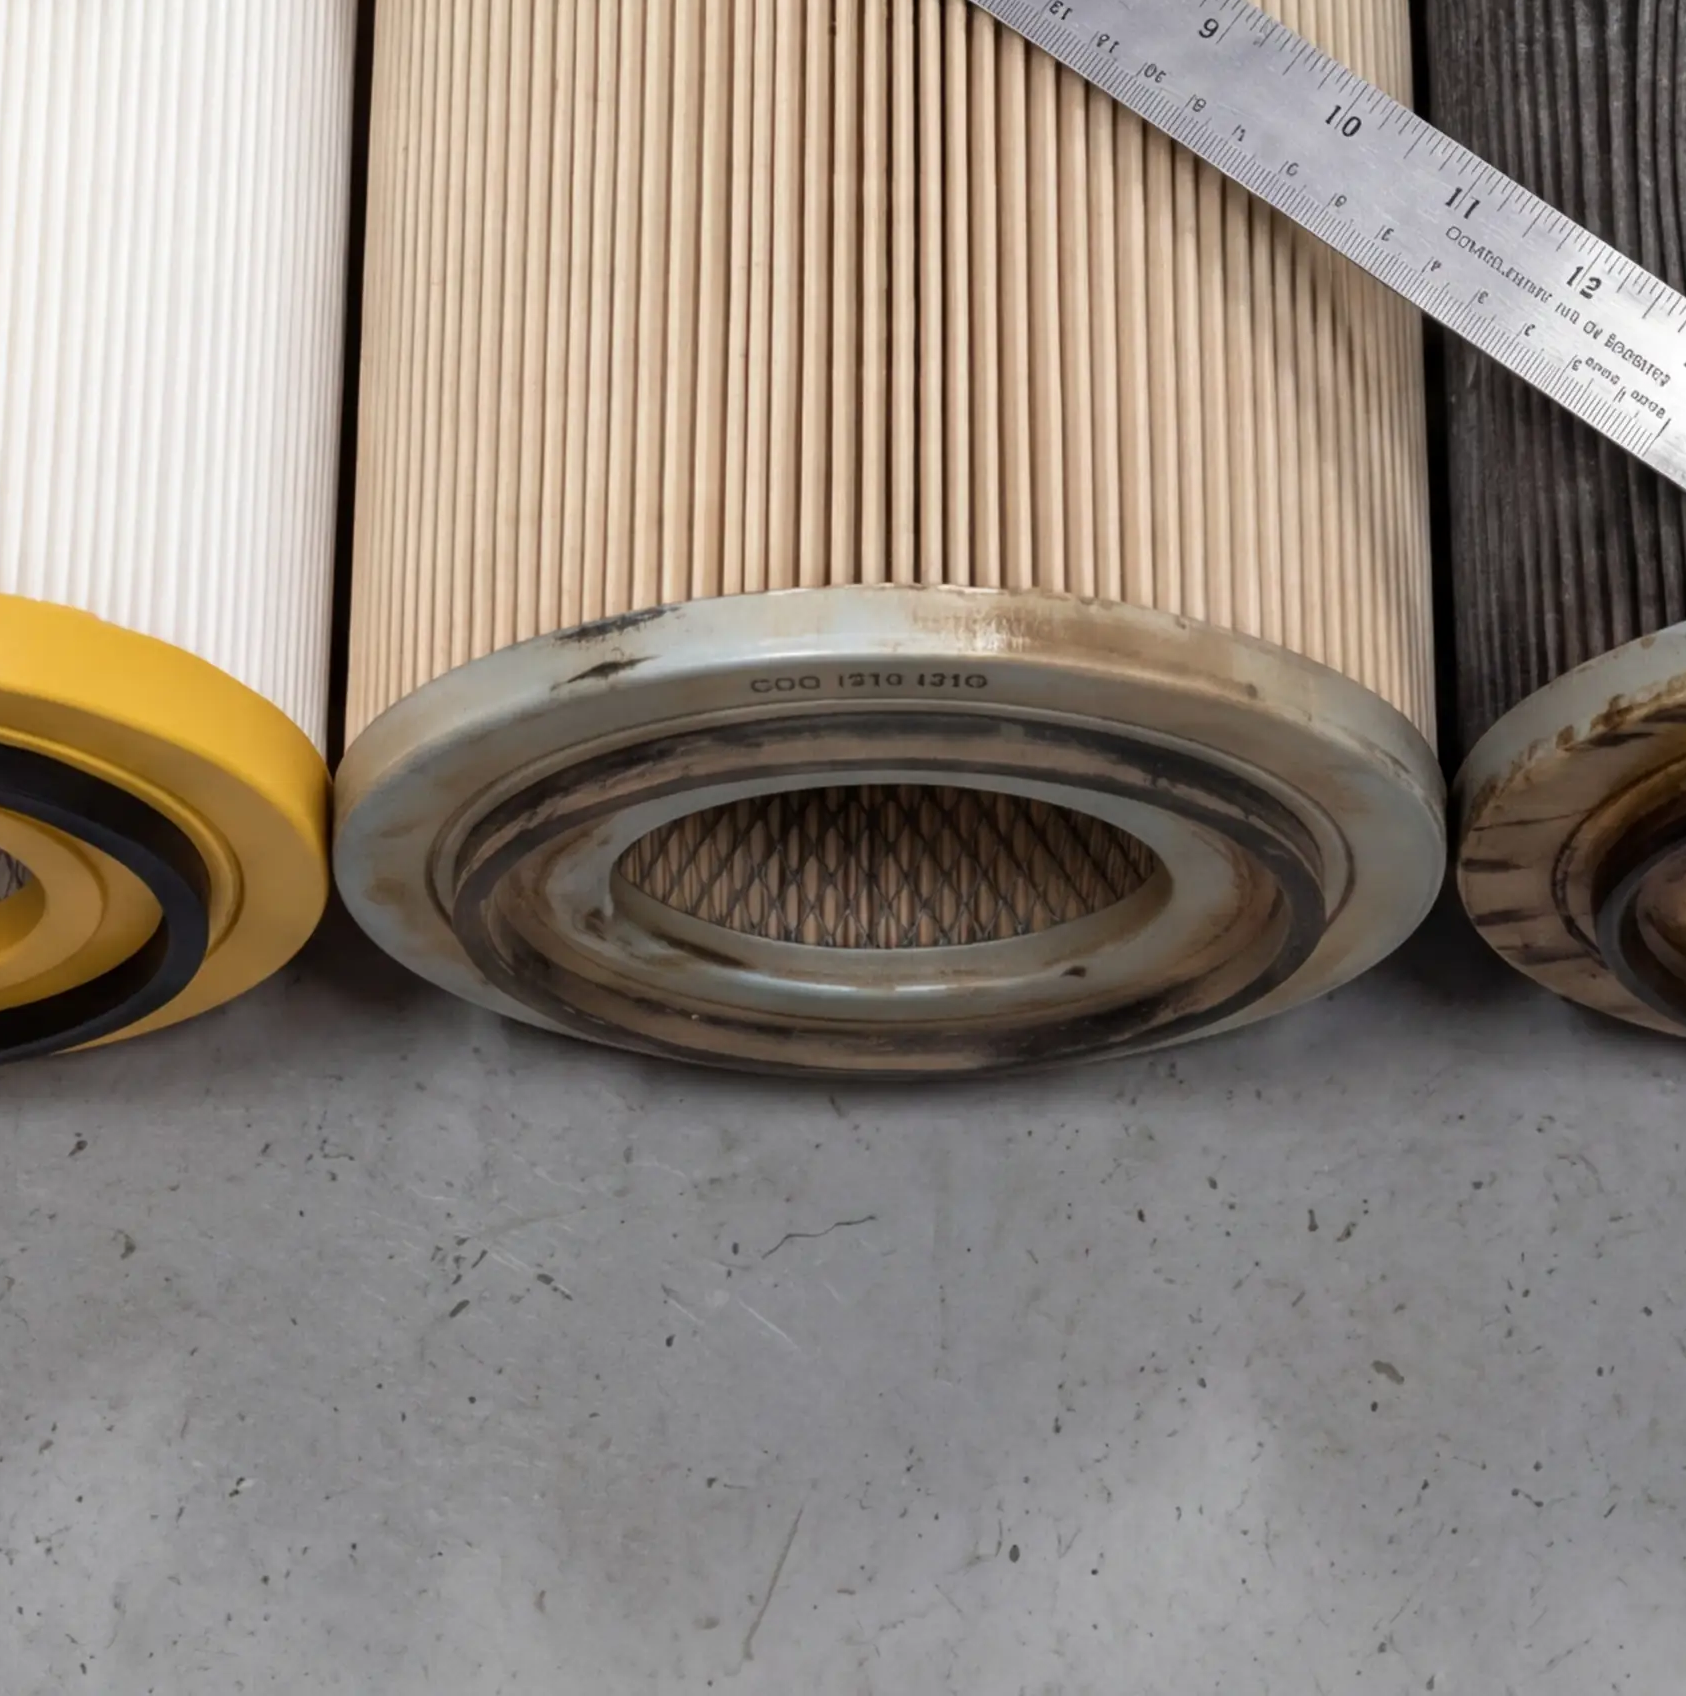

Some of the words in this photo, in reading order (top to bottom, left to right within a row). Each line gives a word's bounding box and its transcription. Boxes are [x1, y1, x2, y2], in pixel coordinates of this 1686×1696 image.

[1197, 17, 1220, 40] 9
[1324, 104, 1363, 139] 10
[1444, 186, 1482, 221] 11
